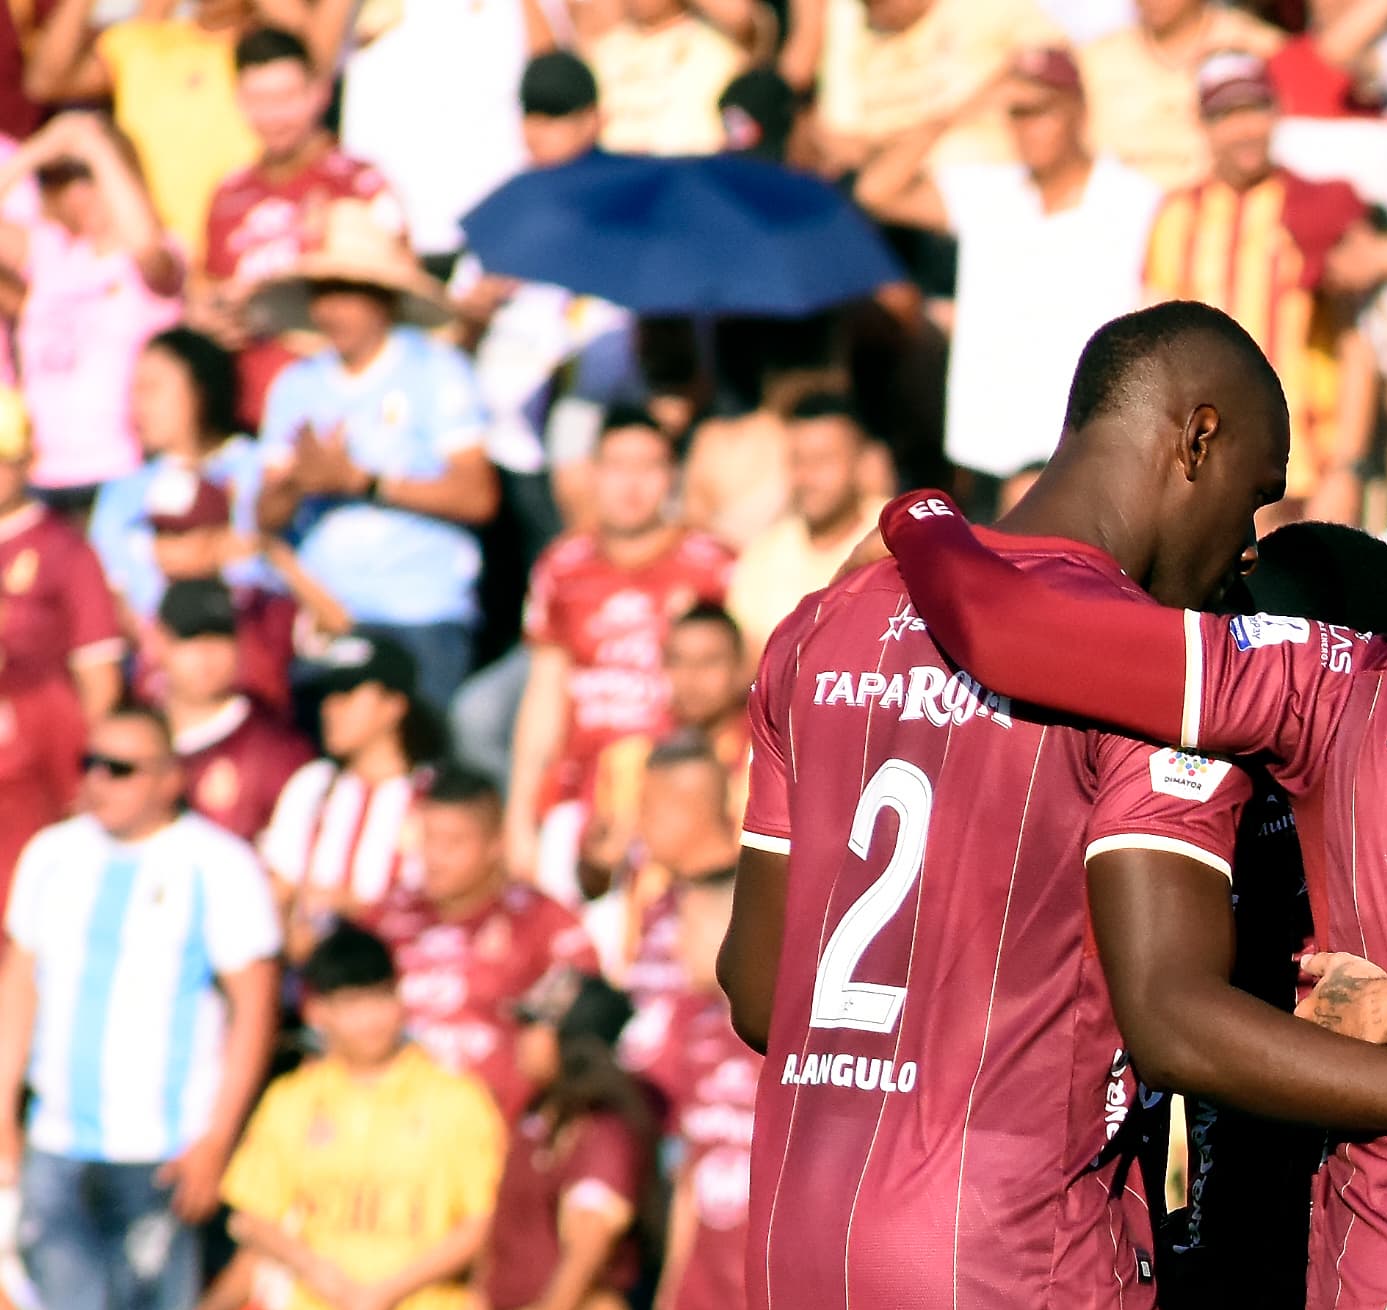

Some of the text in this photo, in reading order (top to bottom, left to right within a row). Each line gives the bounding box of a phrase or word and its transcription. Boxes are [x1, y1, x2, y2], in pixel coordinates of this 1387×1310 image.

[813, 670, 904, 709] TAPA
[808, 757, 935, 1035] 2
[780, 1051, 919, 1094] A.ANGULO
